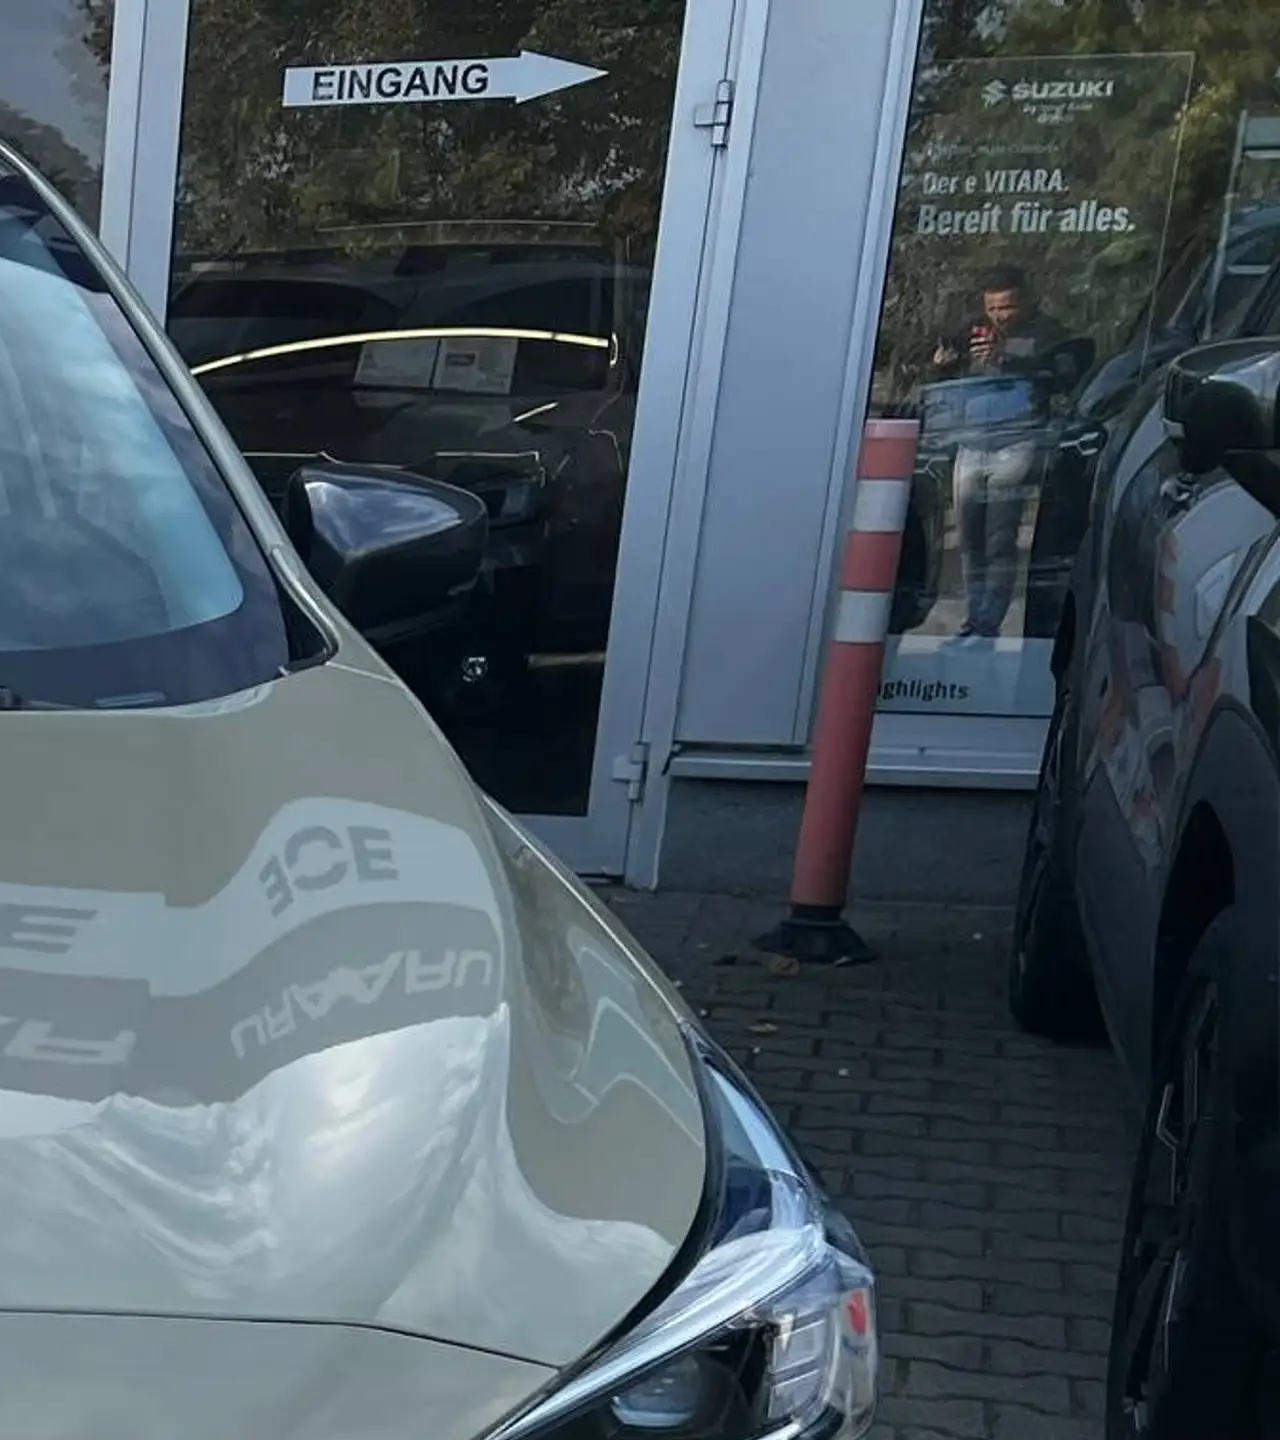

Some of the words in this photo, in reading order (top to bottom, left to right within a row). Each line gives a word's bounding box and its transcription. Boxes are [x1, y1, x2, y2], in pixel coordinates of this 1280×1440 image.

[312, 64, 489, 101] EINGANG
[1012, 80, 1115, 99] SUZUKI
[923, 172, 957, 195] Der
[965, 177, 977, 194] e
[985, 169, 1070, 194] VITARA.
[918, 202, 1002, 235] Bereit
[1011, 201, 1052, 234] für
[1059, 200, 1136, 233] alles.
